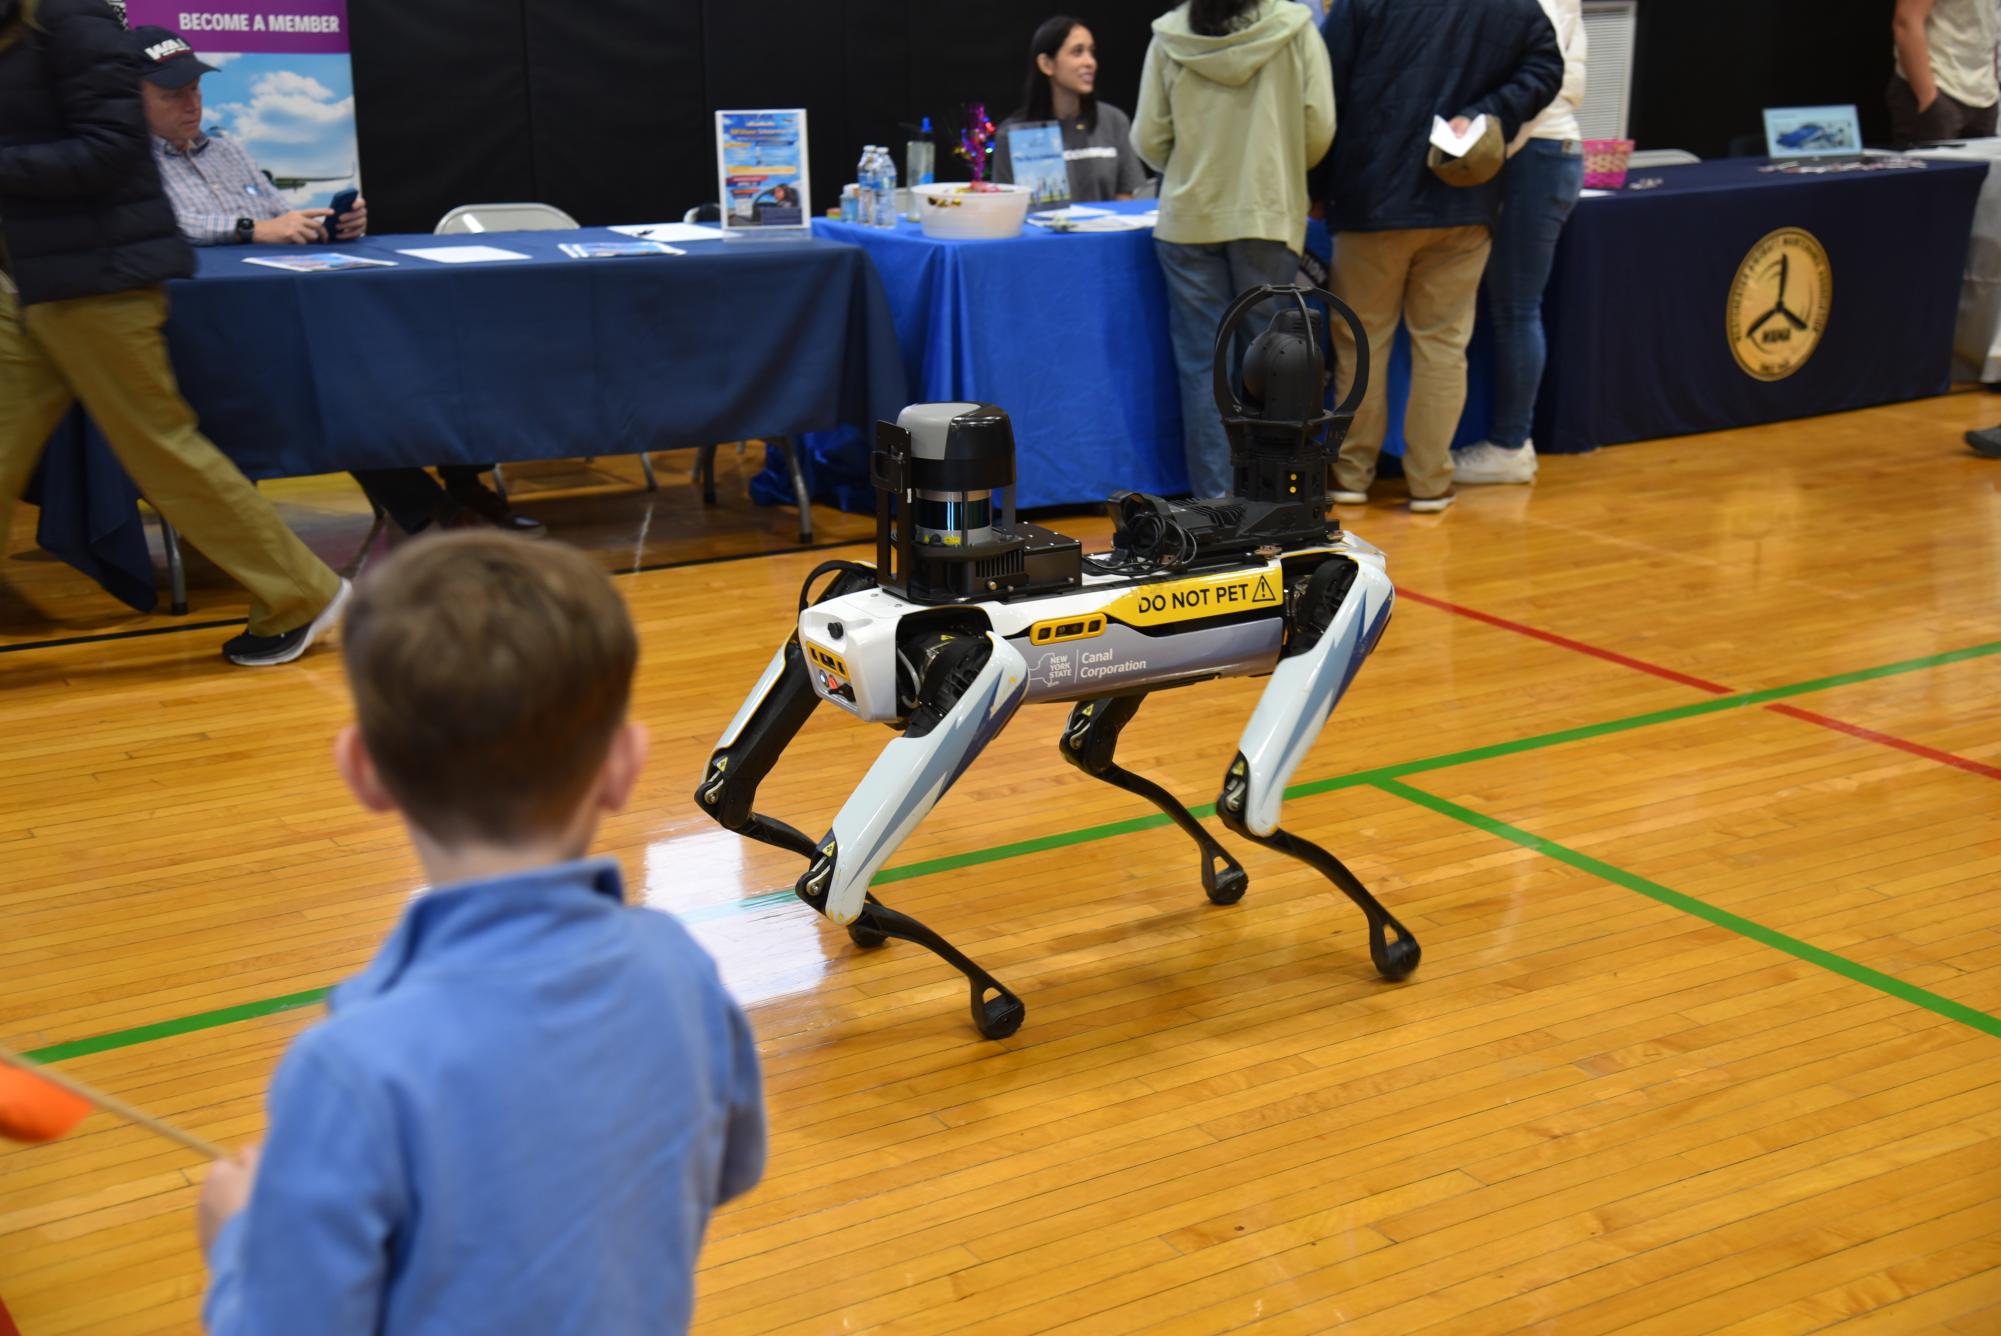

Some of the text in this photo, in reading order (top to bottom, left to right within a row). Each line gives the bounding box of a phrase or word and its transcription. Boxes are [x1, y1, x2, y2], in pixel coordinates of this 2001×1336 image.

[179, 13, 340, 32] BECOME A MEMBER
[1138, 583, 1249, 614] DO NOT PET
[1050, 655, 1068, 664] NEW
[1081, 648, 1113, 664] Canal
[1049, 669, 1072, 679] STATE
[1050, 662, 1071, 671] YORK
[1080, 660, 1147, 679] Corporation
